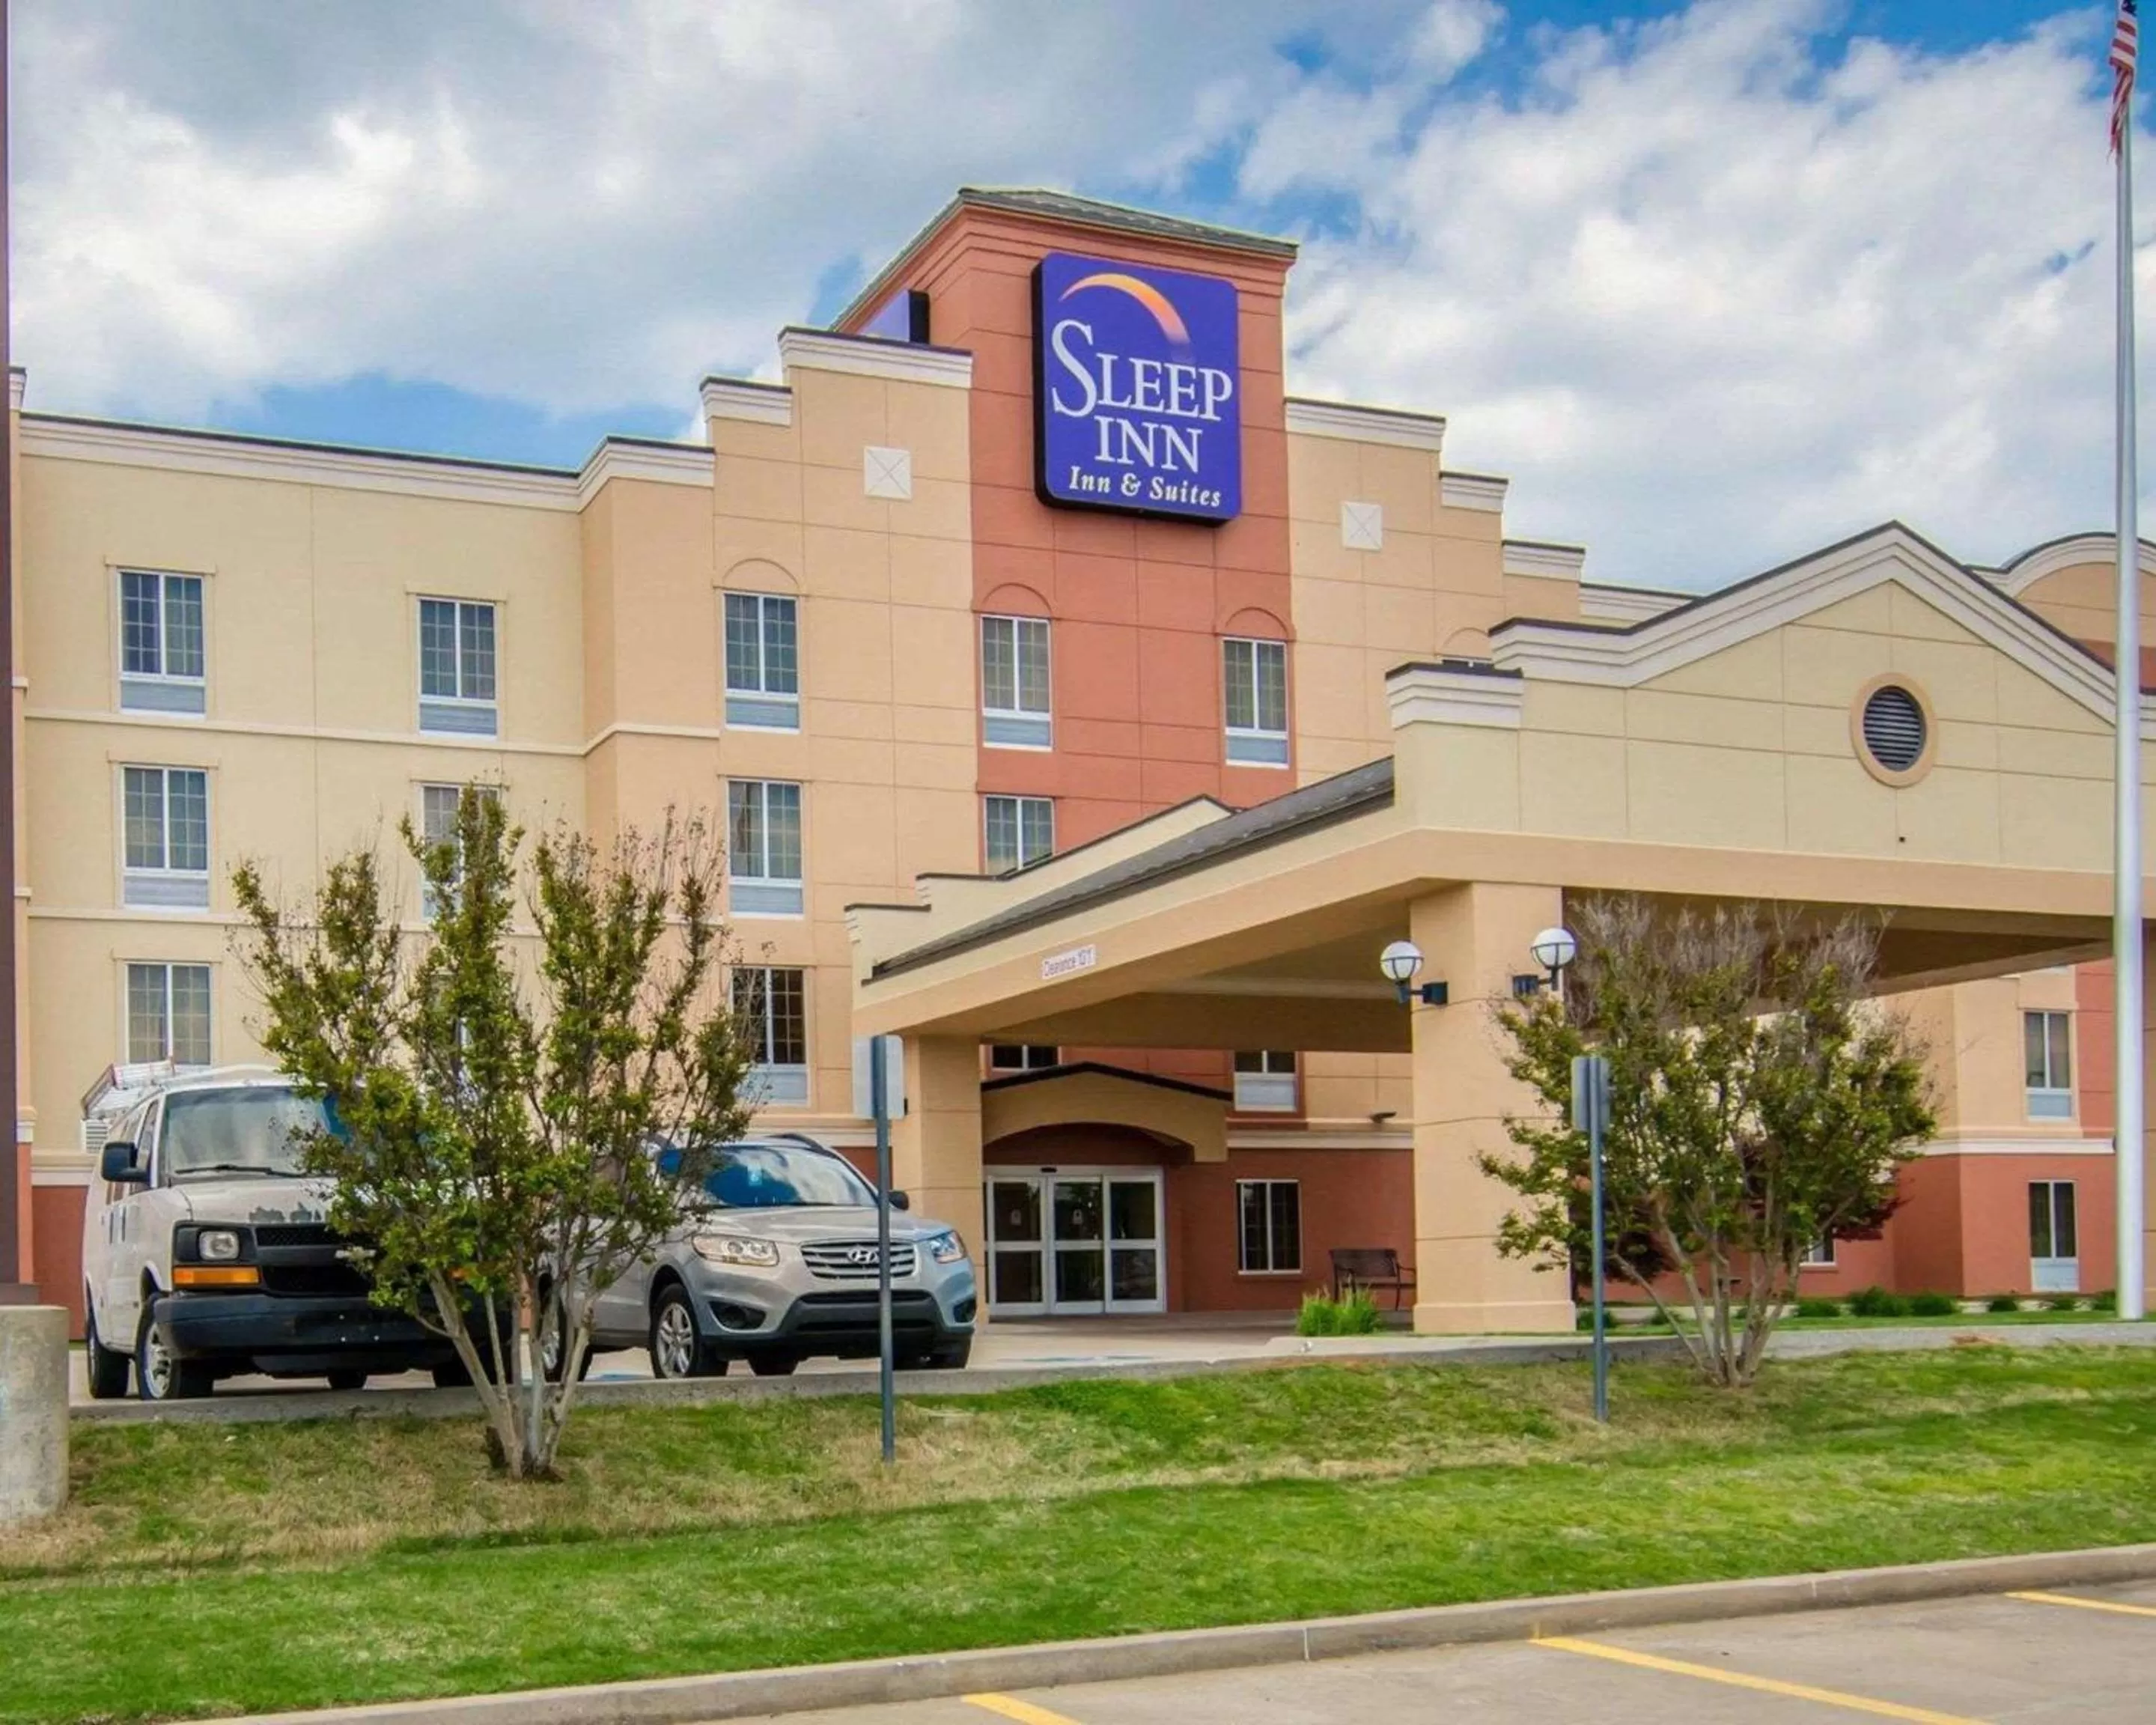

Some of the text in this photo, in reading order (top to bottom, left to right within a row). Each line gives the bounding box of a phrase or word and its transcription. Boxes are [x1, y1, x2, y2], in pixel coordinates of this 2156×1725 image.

[1051, 319, 1233, 421] SLEEP
[1094, 415, 1203, 473] INN
[1069, 465, 1222, 508] Inn & Suites
